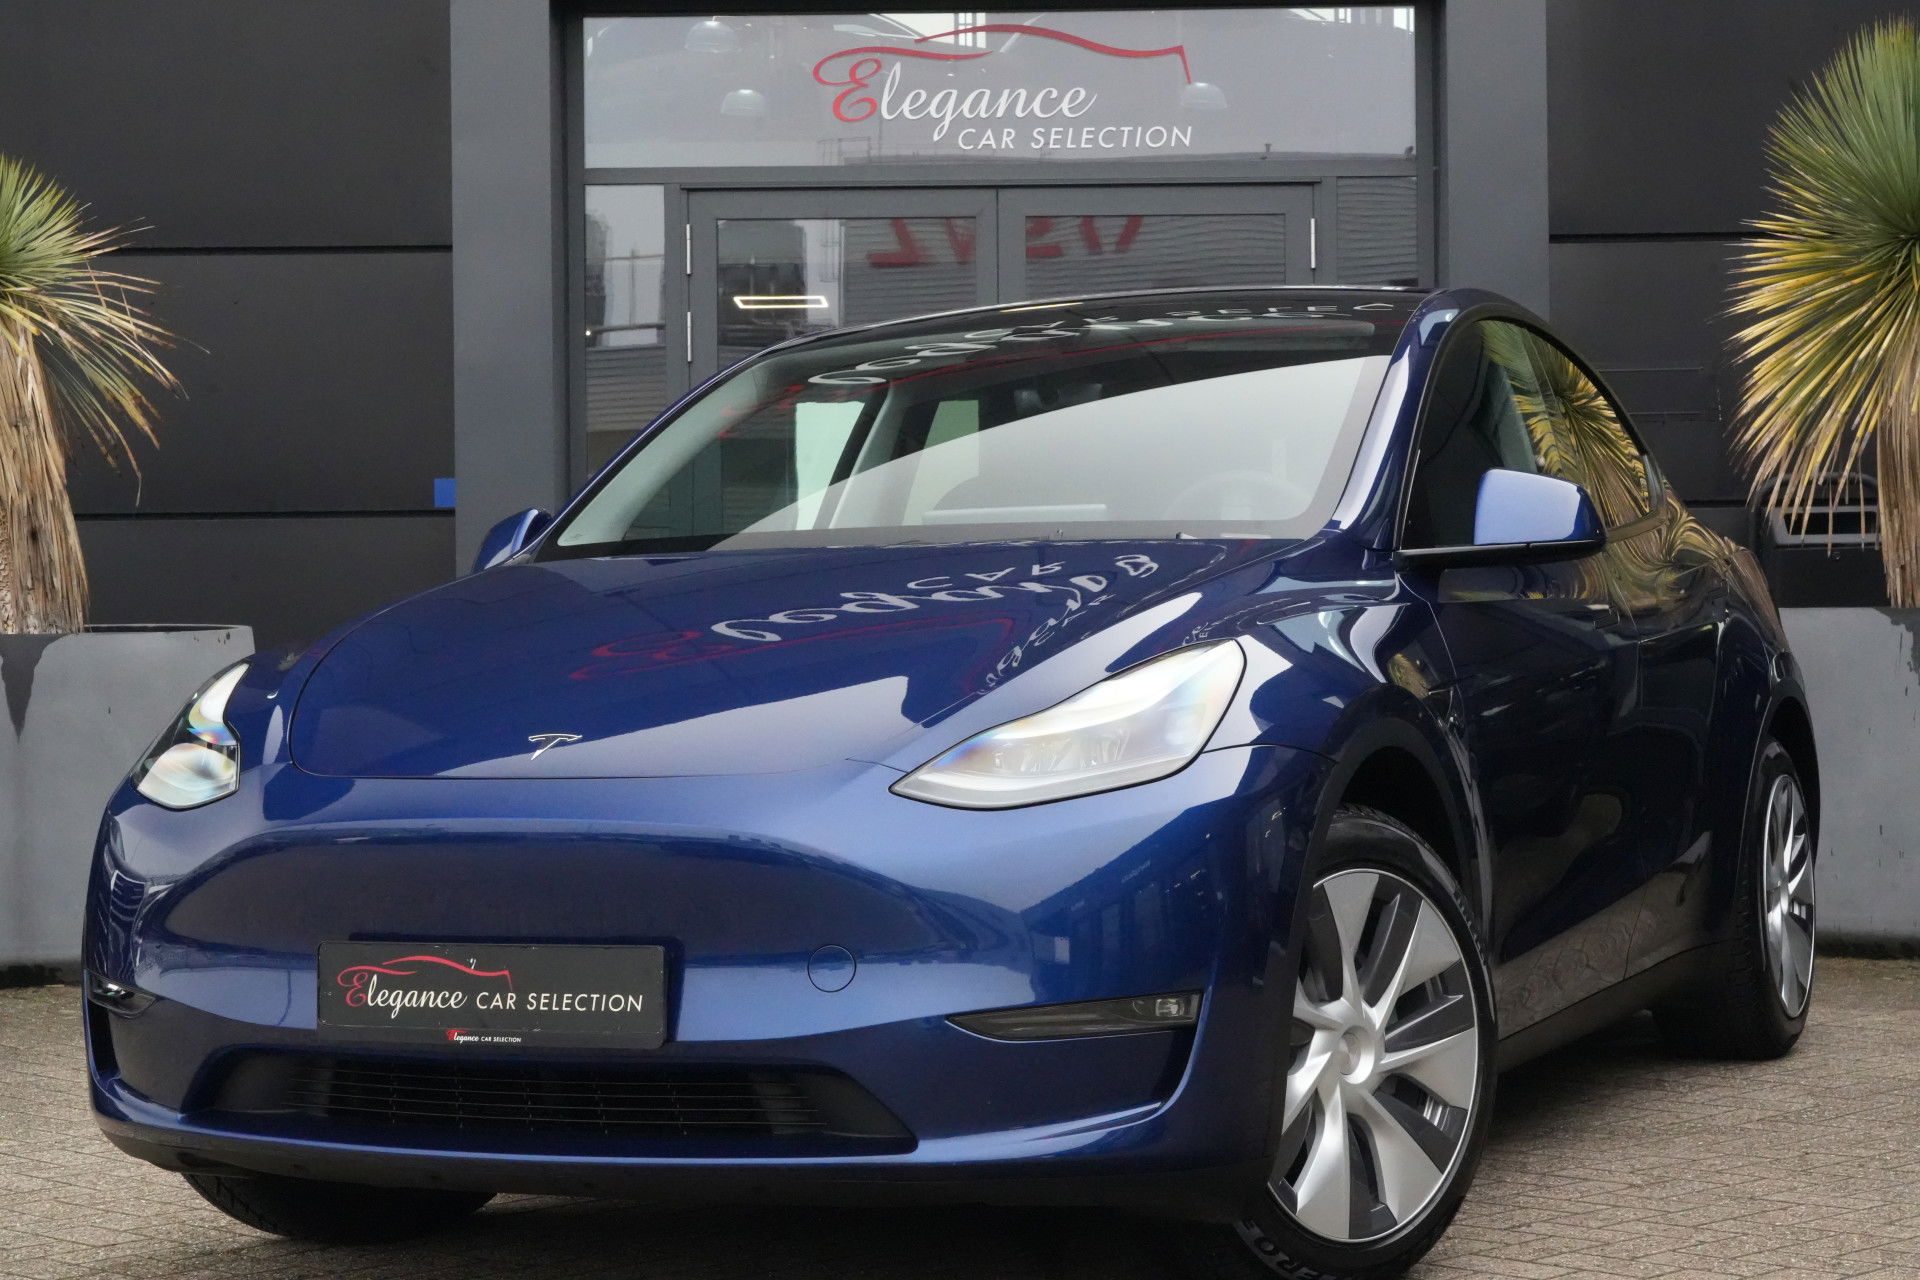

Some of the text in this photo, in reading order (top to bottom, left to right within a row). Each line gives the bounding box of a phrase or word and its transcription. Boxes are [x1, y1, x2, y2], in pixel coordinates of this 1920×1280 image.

[813, 47, 1097, 141] Elegance
[958, 126, 1192, 150] CAR SELECTION
[337, 965, 644, 1019] Elegance CAR SELECTION
